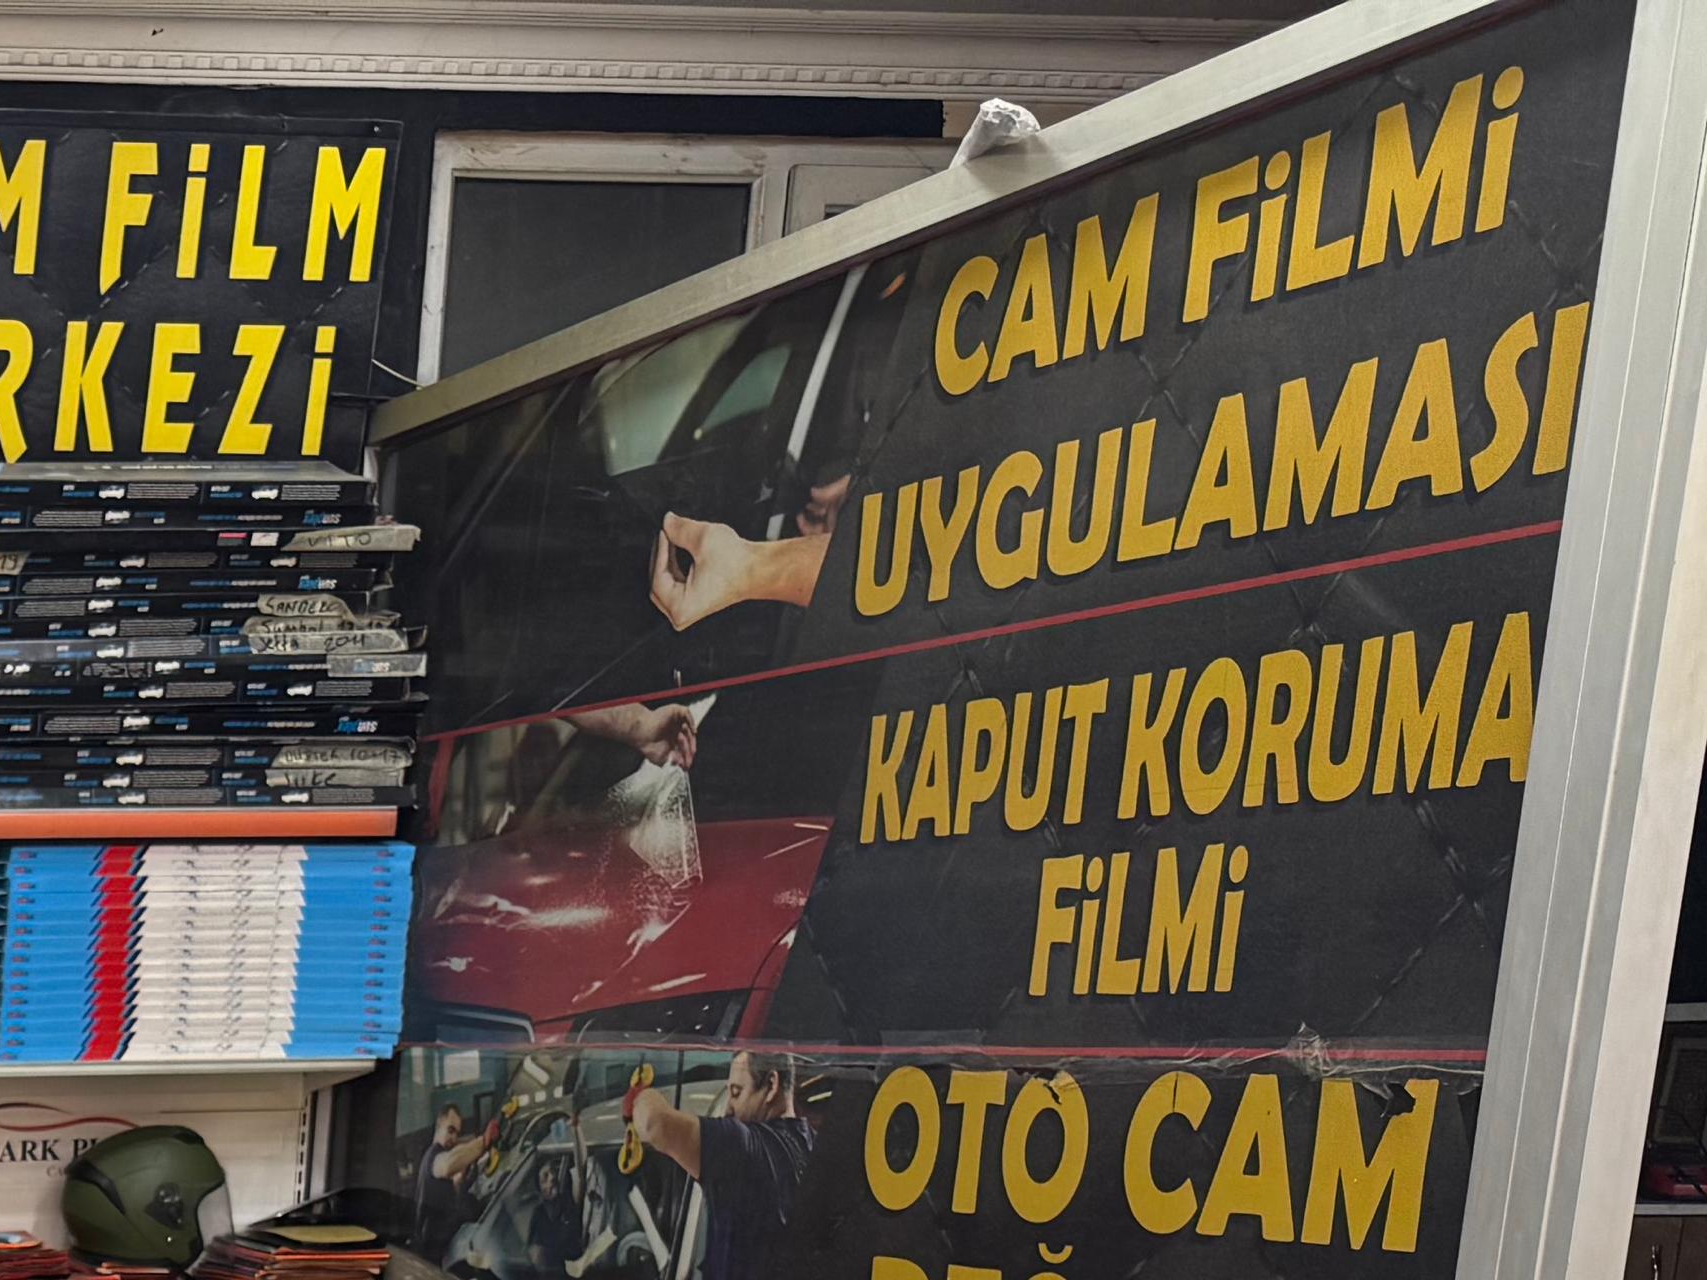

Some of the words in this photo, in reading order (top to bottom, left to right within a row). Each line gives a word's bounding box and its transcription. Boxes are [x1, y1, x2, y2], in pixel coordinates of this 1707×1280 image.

[936, 194, 1160, 397] CAM
[856, 303, 1590, 617] UYGULAMASI
[860, 678, 1110, 844] KAPUT
[1118, 611, 1535, 820] KORUMA
[864, 1065, 1090, 1225] OTO
[1124, 1072, 1441, 1254] CAM
